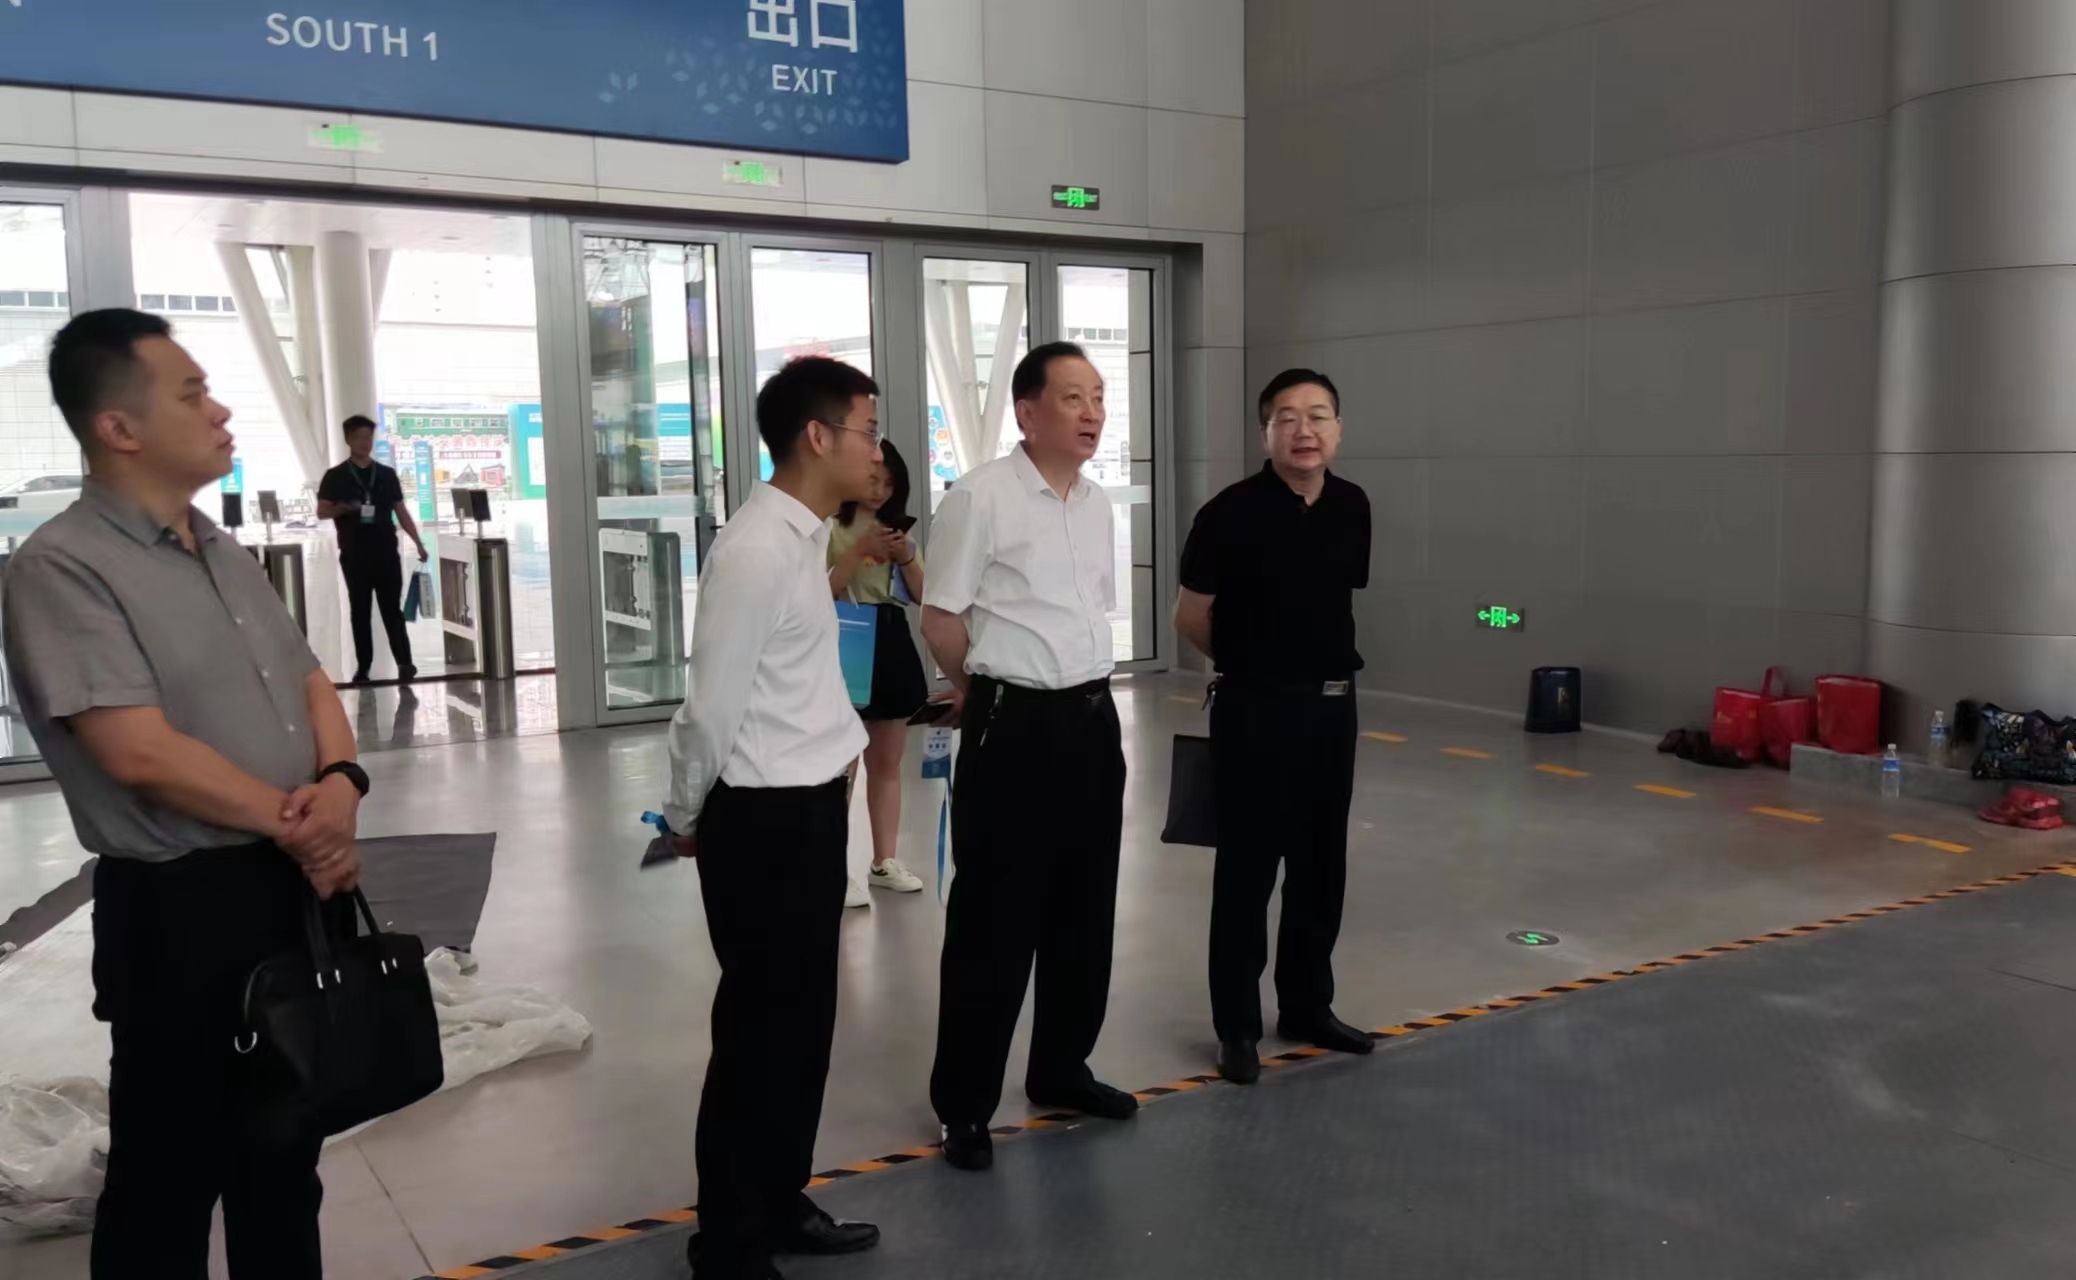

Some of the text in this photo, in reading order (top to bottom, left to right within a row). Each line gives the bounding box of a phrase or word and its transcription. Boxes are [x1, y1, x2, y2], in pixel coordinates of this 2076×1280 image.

[266, 12, 438, 61] SOUTH 1
[747, 0, 858, 53] 出口
[771, 63, 838, 96] EXIT
